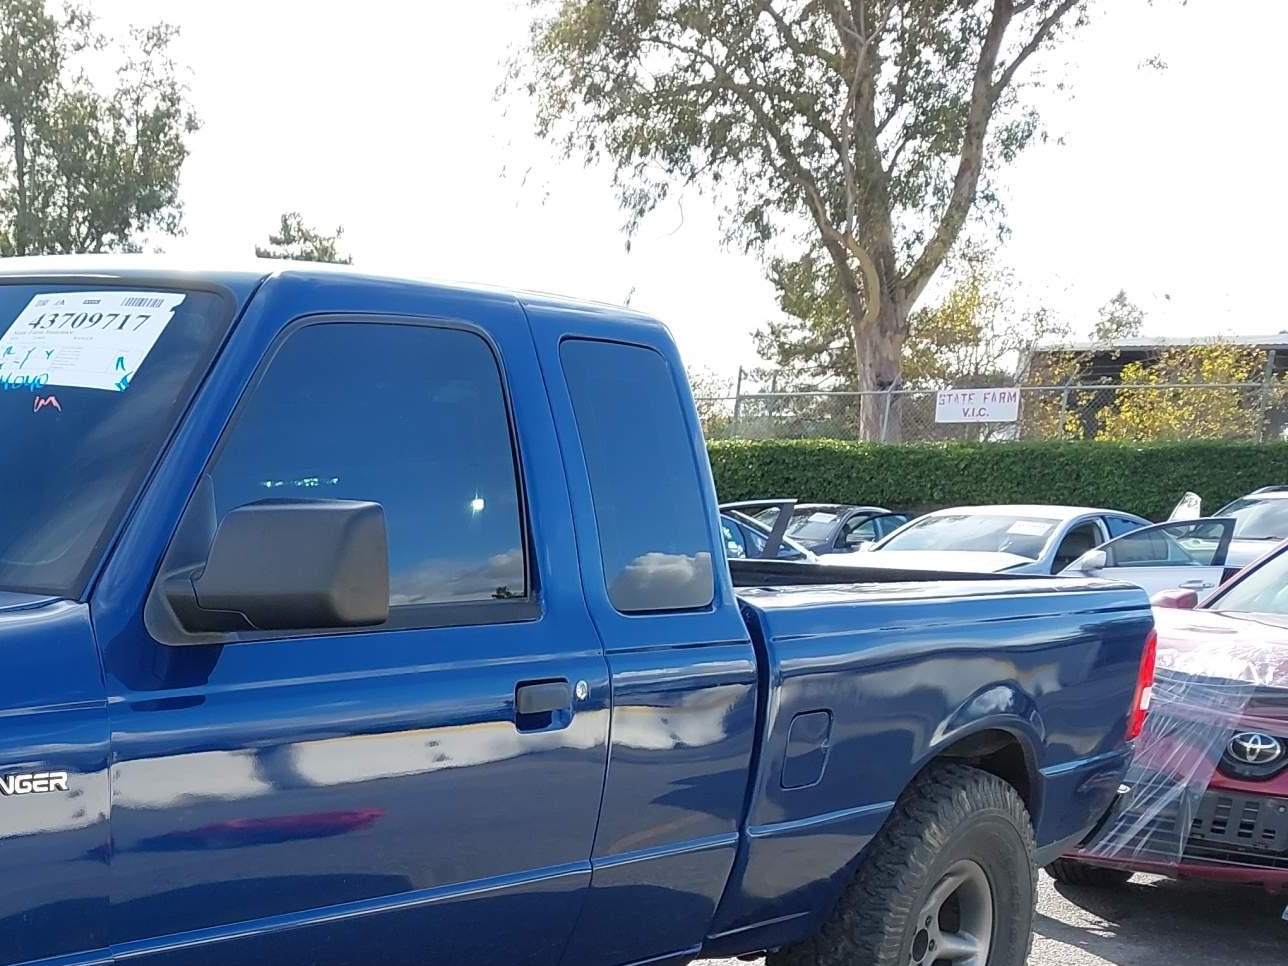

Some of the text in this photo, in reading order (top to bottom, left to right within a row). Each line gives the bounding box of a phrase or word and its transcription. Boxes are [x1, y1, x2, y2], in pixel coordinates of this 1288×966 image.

[28, 311, 151, 332] 43709717
[938, 391, 1017, 406] STATE FARM
[961, 407, 990, 417] V.I.C.
